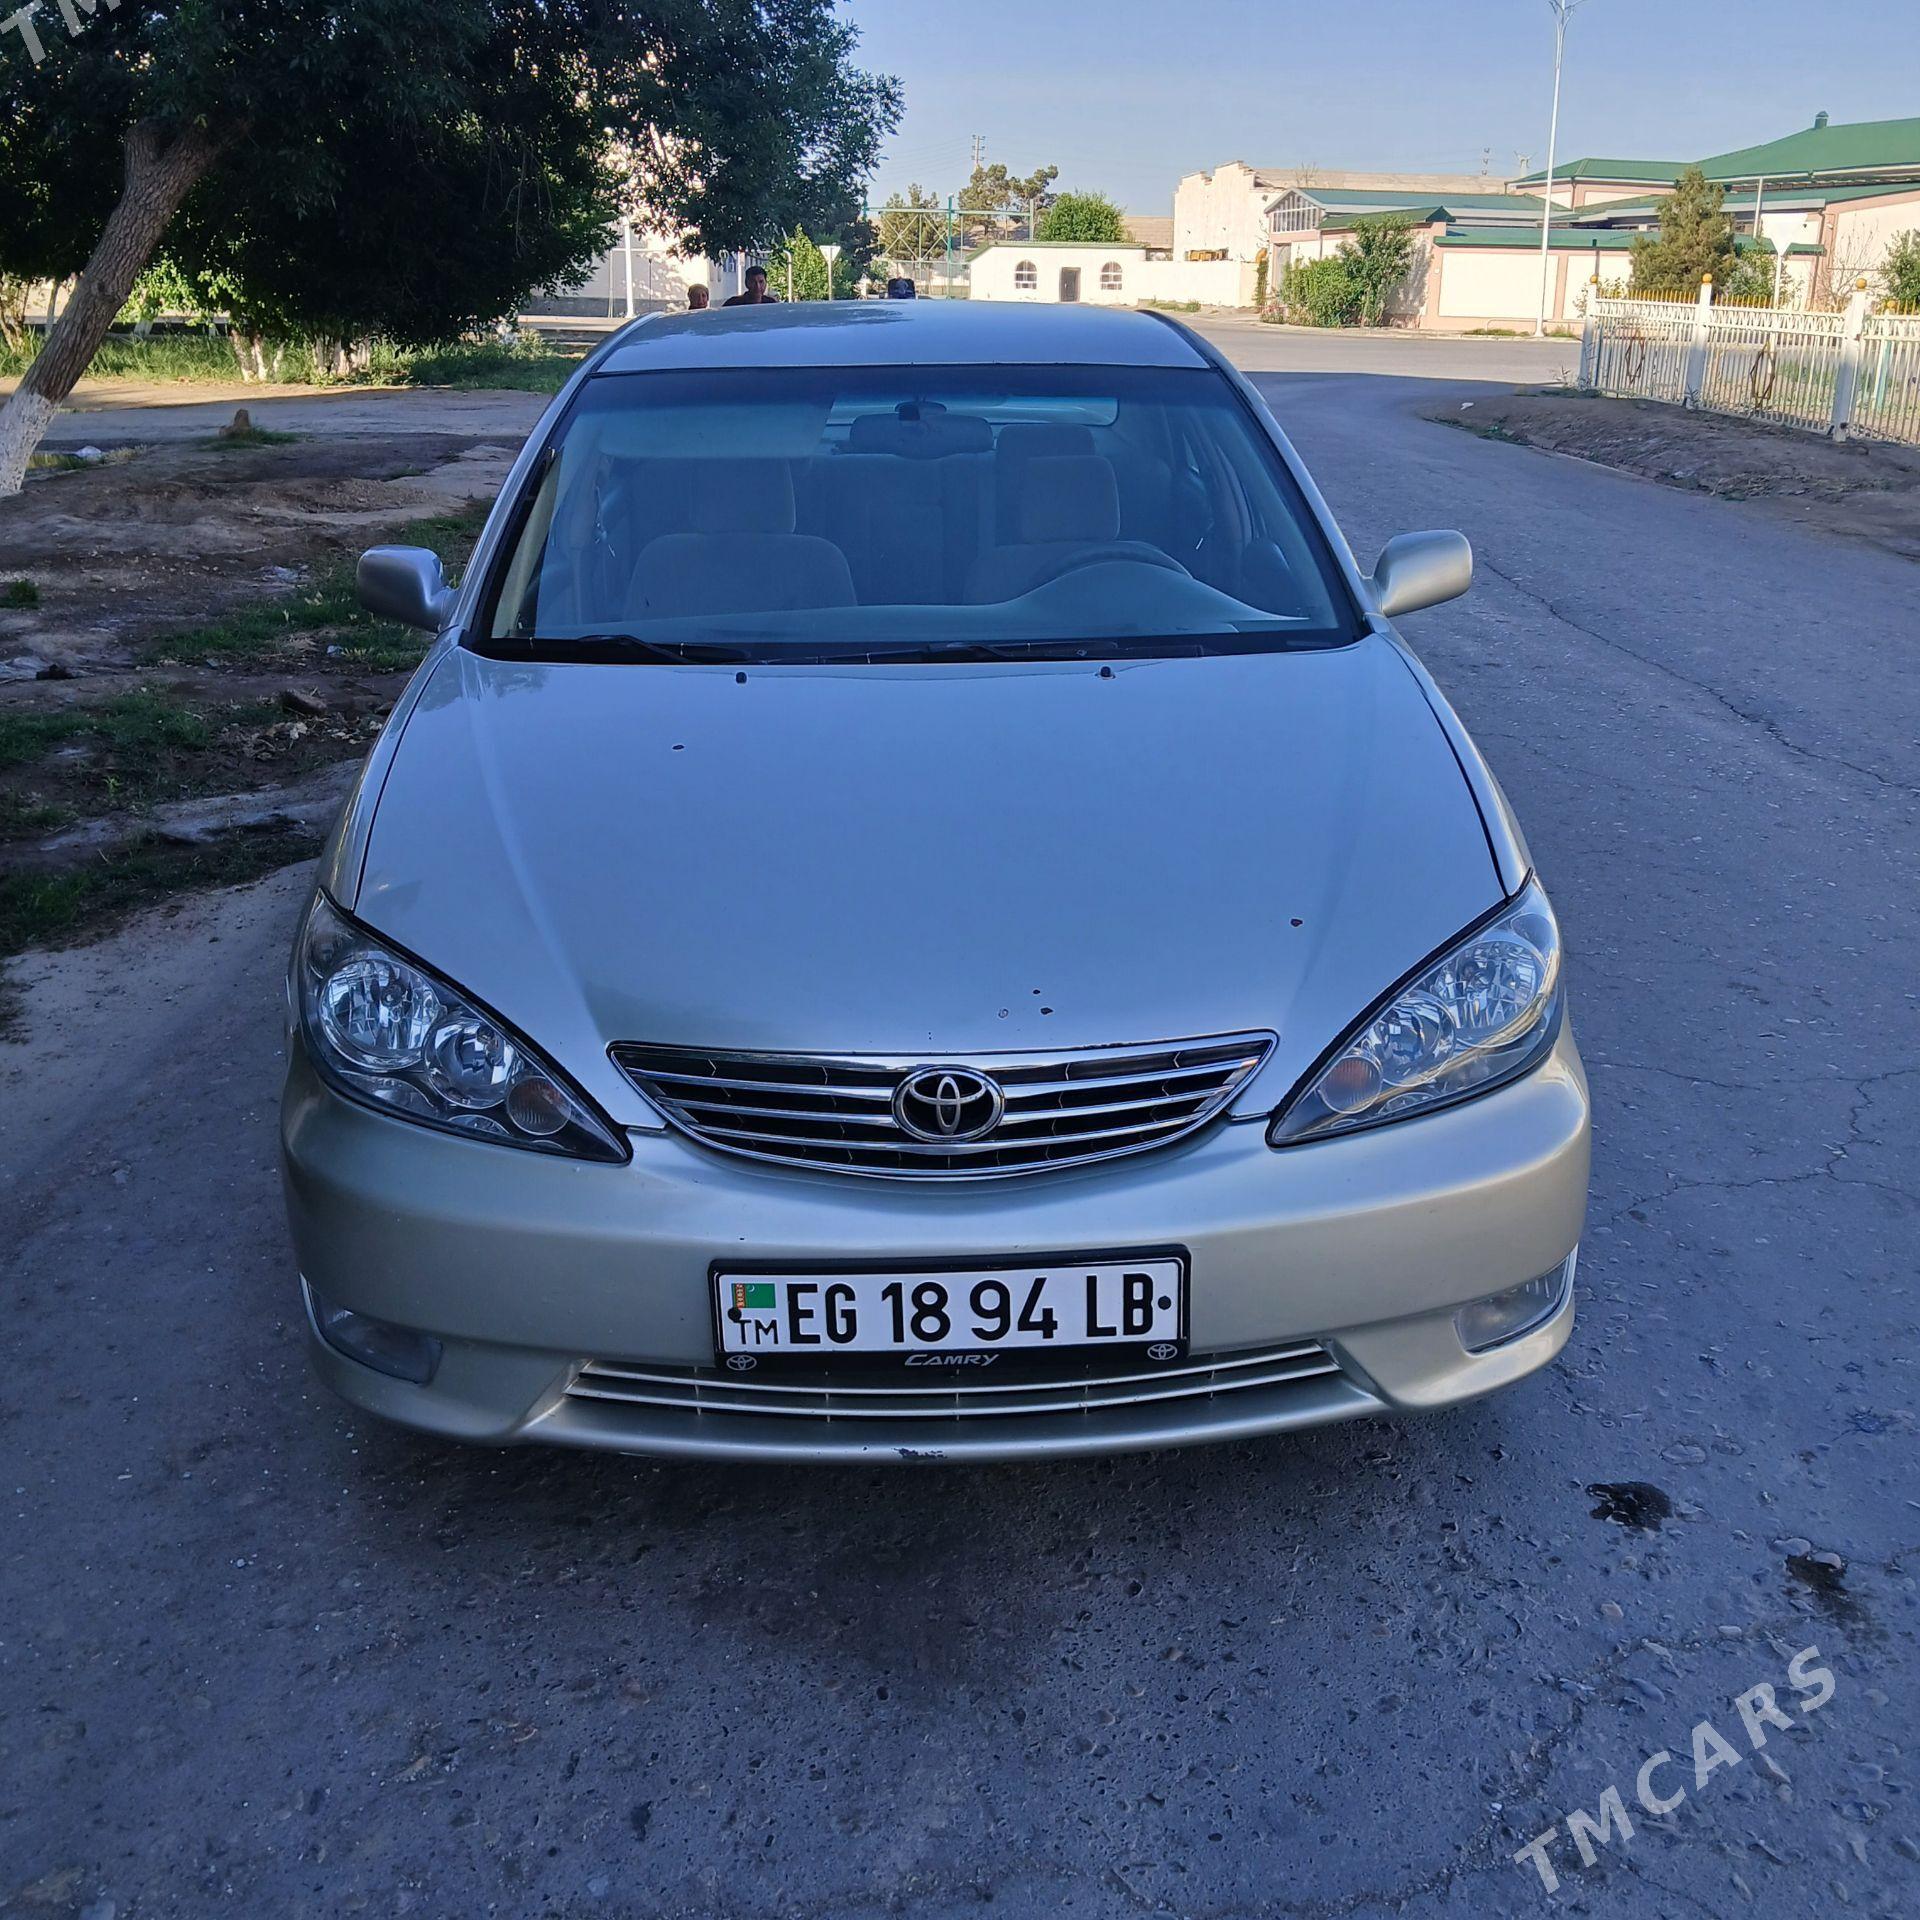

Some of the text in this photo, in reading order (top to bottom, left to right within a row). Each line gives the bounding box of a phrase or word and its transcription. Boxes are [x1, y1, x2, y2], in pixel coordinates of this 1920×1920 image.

[787, 1272, 1153, 1344] EG 18 94 LB
[738, 1318, 779, 1345] TM
[904, 1353, 1000, 1367] CAMRY
